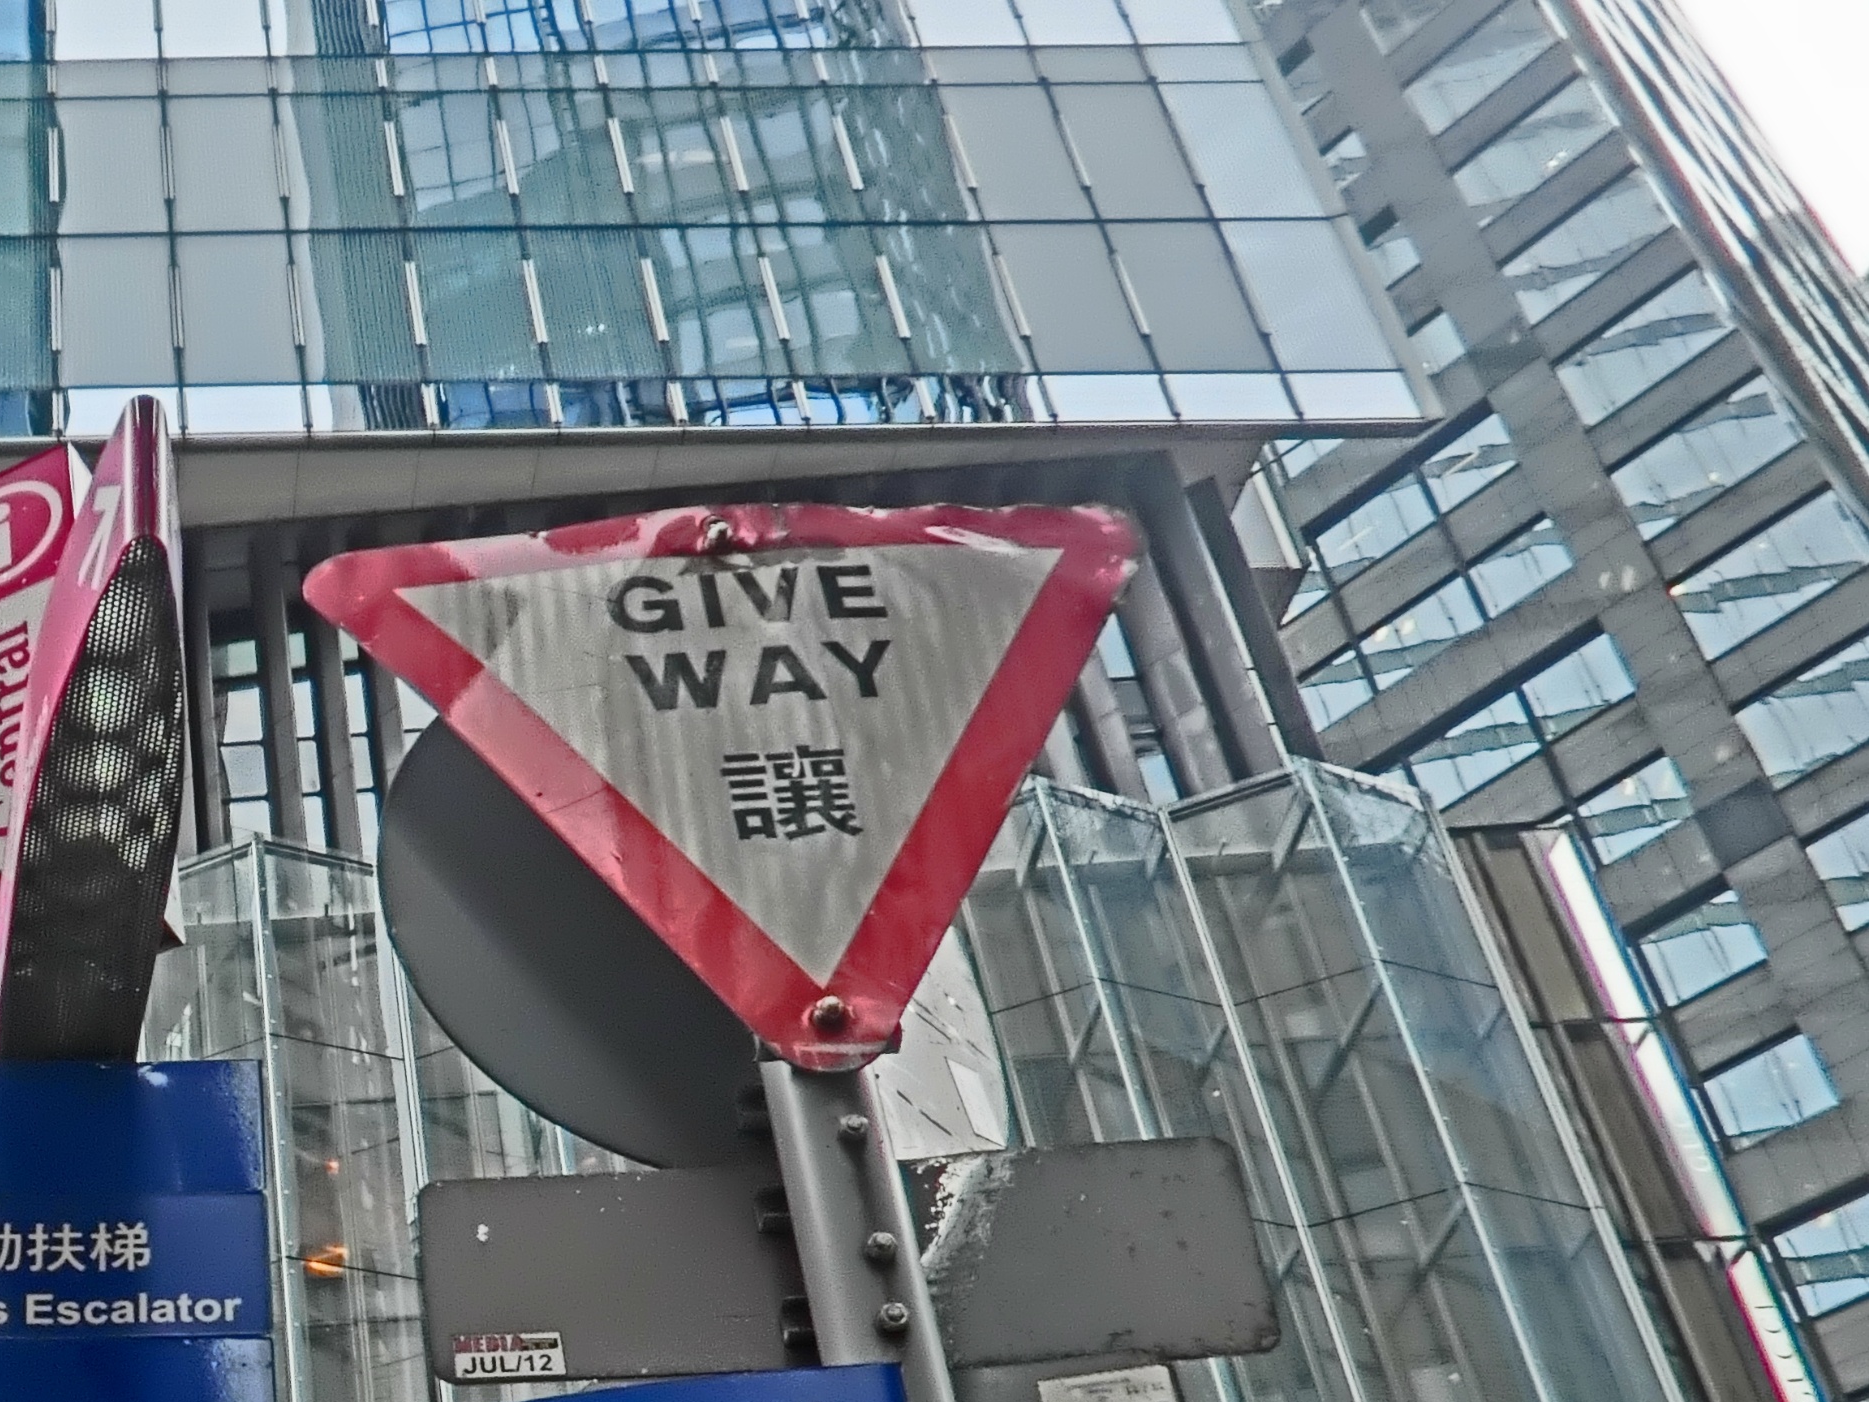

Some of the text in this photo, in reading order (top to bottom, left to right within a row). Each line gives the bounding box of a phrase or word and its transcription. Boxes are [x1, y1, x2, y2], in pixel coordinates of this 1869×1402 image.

[606, 564, 888, 634] GIVE
[625, 639, 892, 711] WAY
[720, 745, 864, 840] 讓
[26, 1292, 242, 1325] Escalator
[463, 1354, 553, 1374] JUL/12
